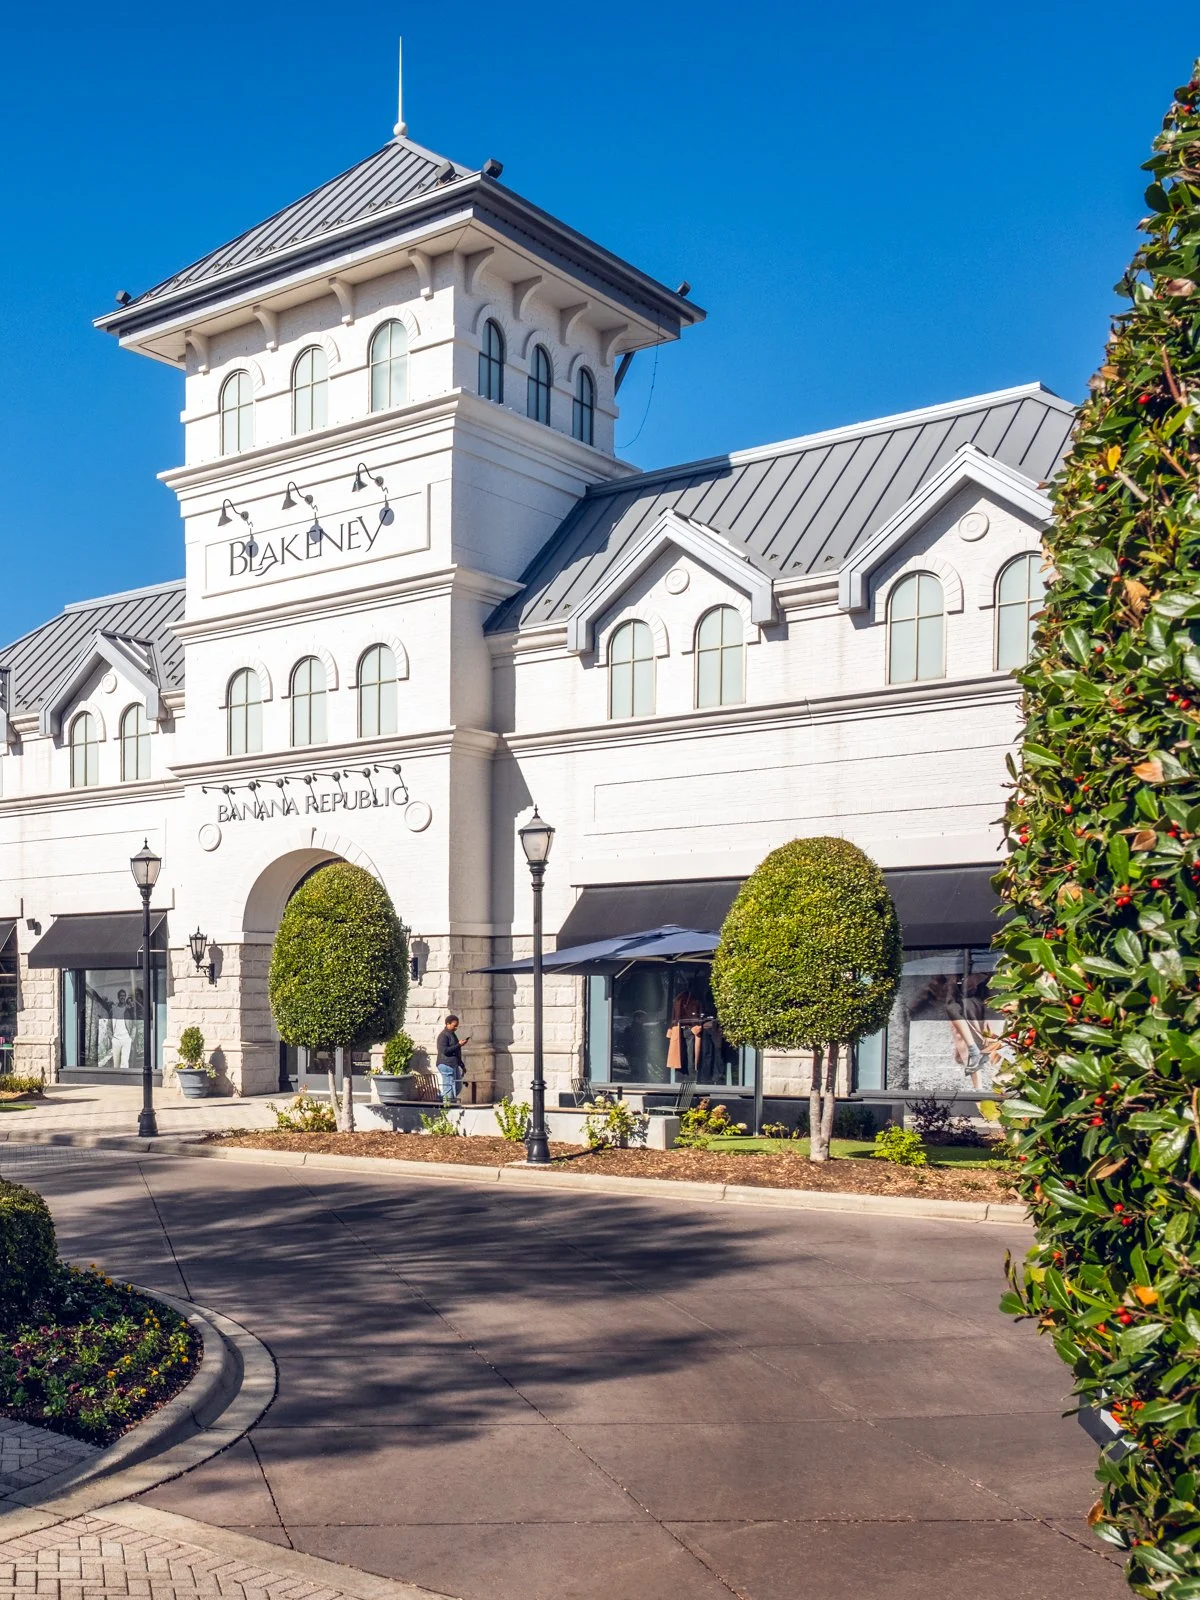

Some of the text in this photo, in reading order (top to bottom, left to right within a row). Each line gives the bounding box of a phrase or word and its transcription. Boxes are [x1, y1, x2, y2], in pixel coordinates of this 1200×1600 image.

[229, 509, 390, 576] BLAKENEY
[218, 786, 409, 823] BANANA REPUBLIC
